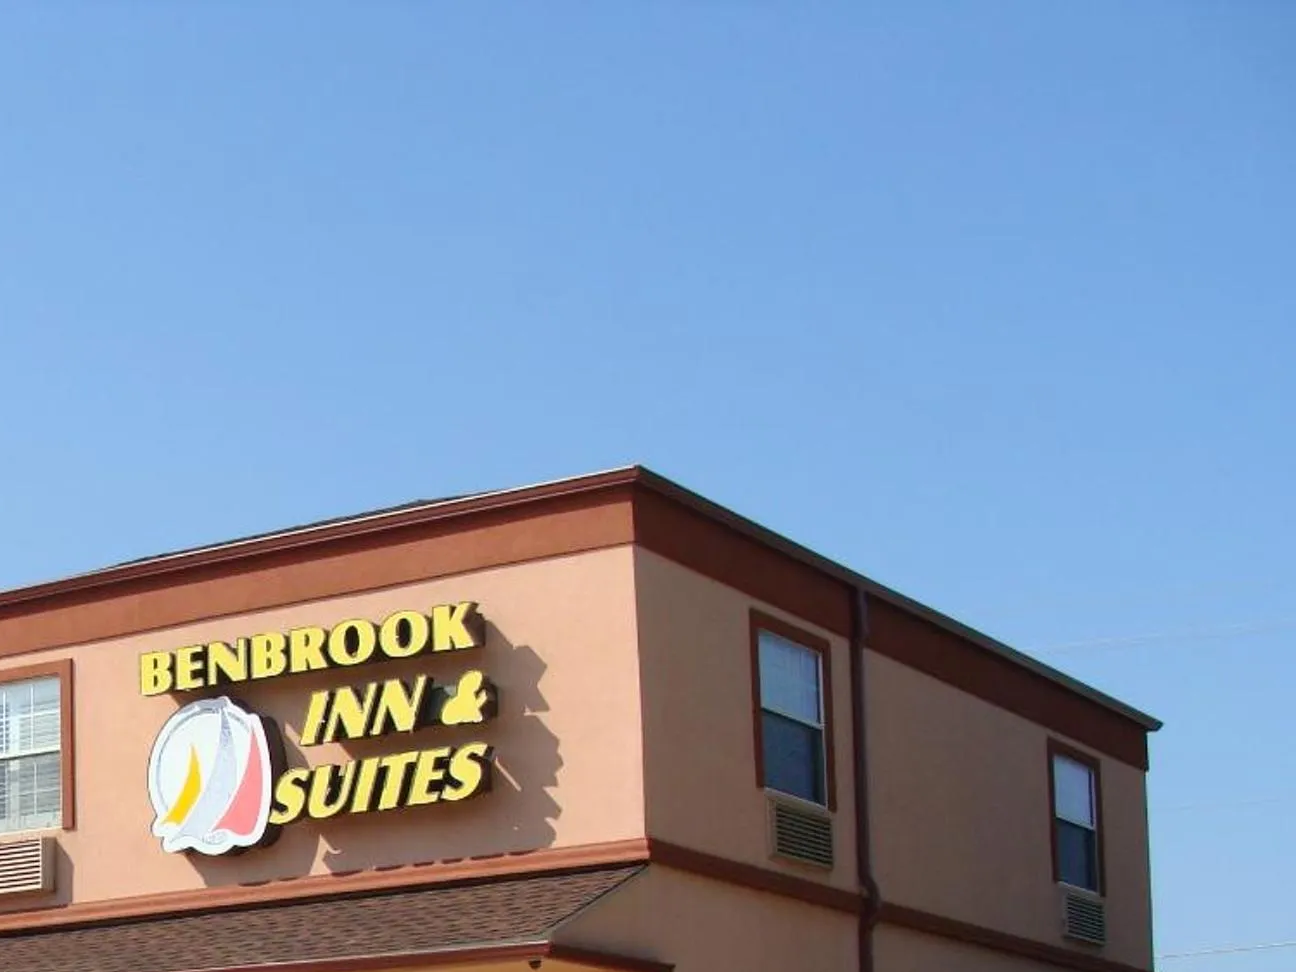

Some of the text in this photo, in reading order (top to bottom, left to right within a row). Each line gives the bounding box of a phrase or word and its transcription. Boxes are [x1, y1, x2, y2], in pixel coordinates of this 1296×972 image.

[140, 601, 481, 696] BENBROOK
[300, 669, 492, 746] INN &
[269, 742, 490, 825] SUITES
